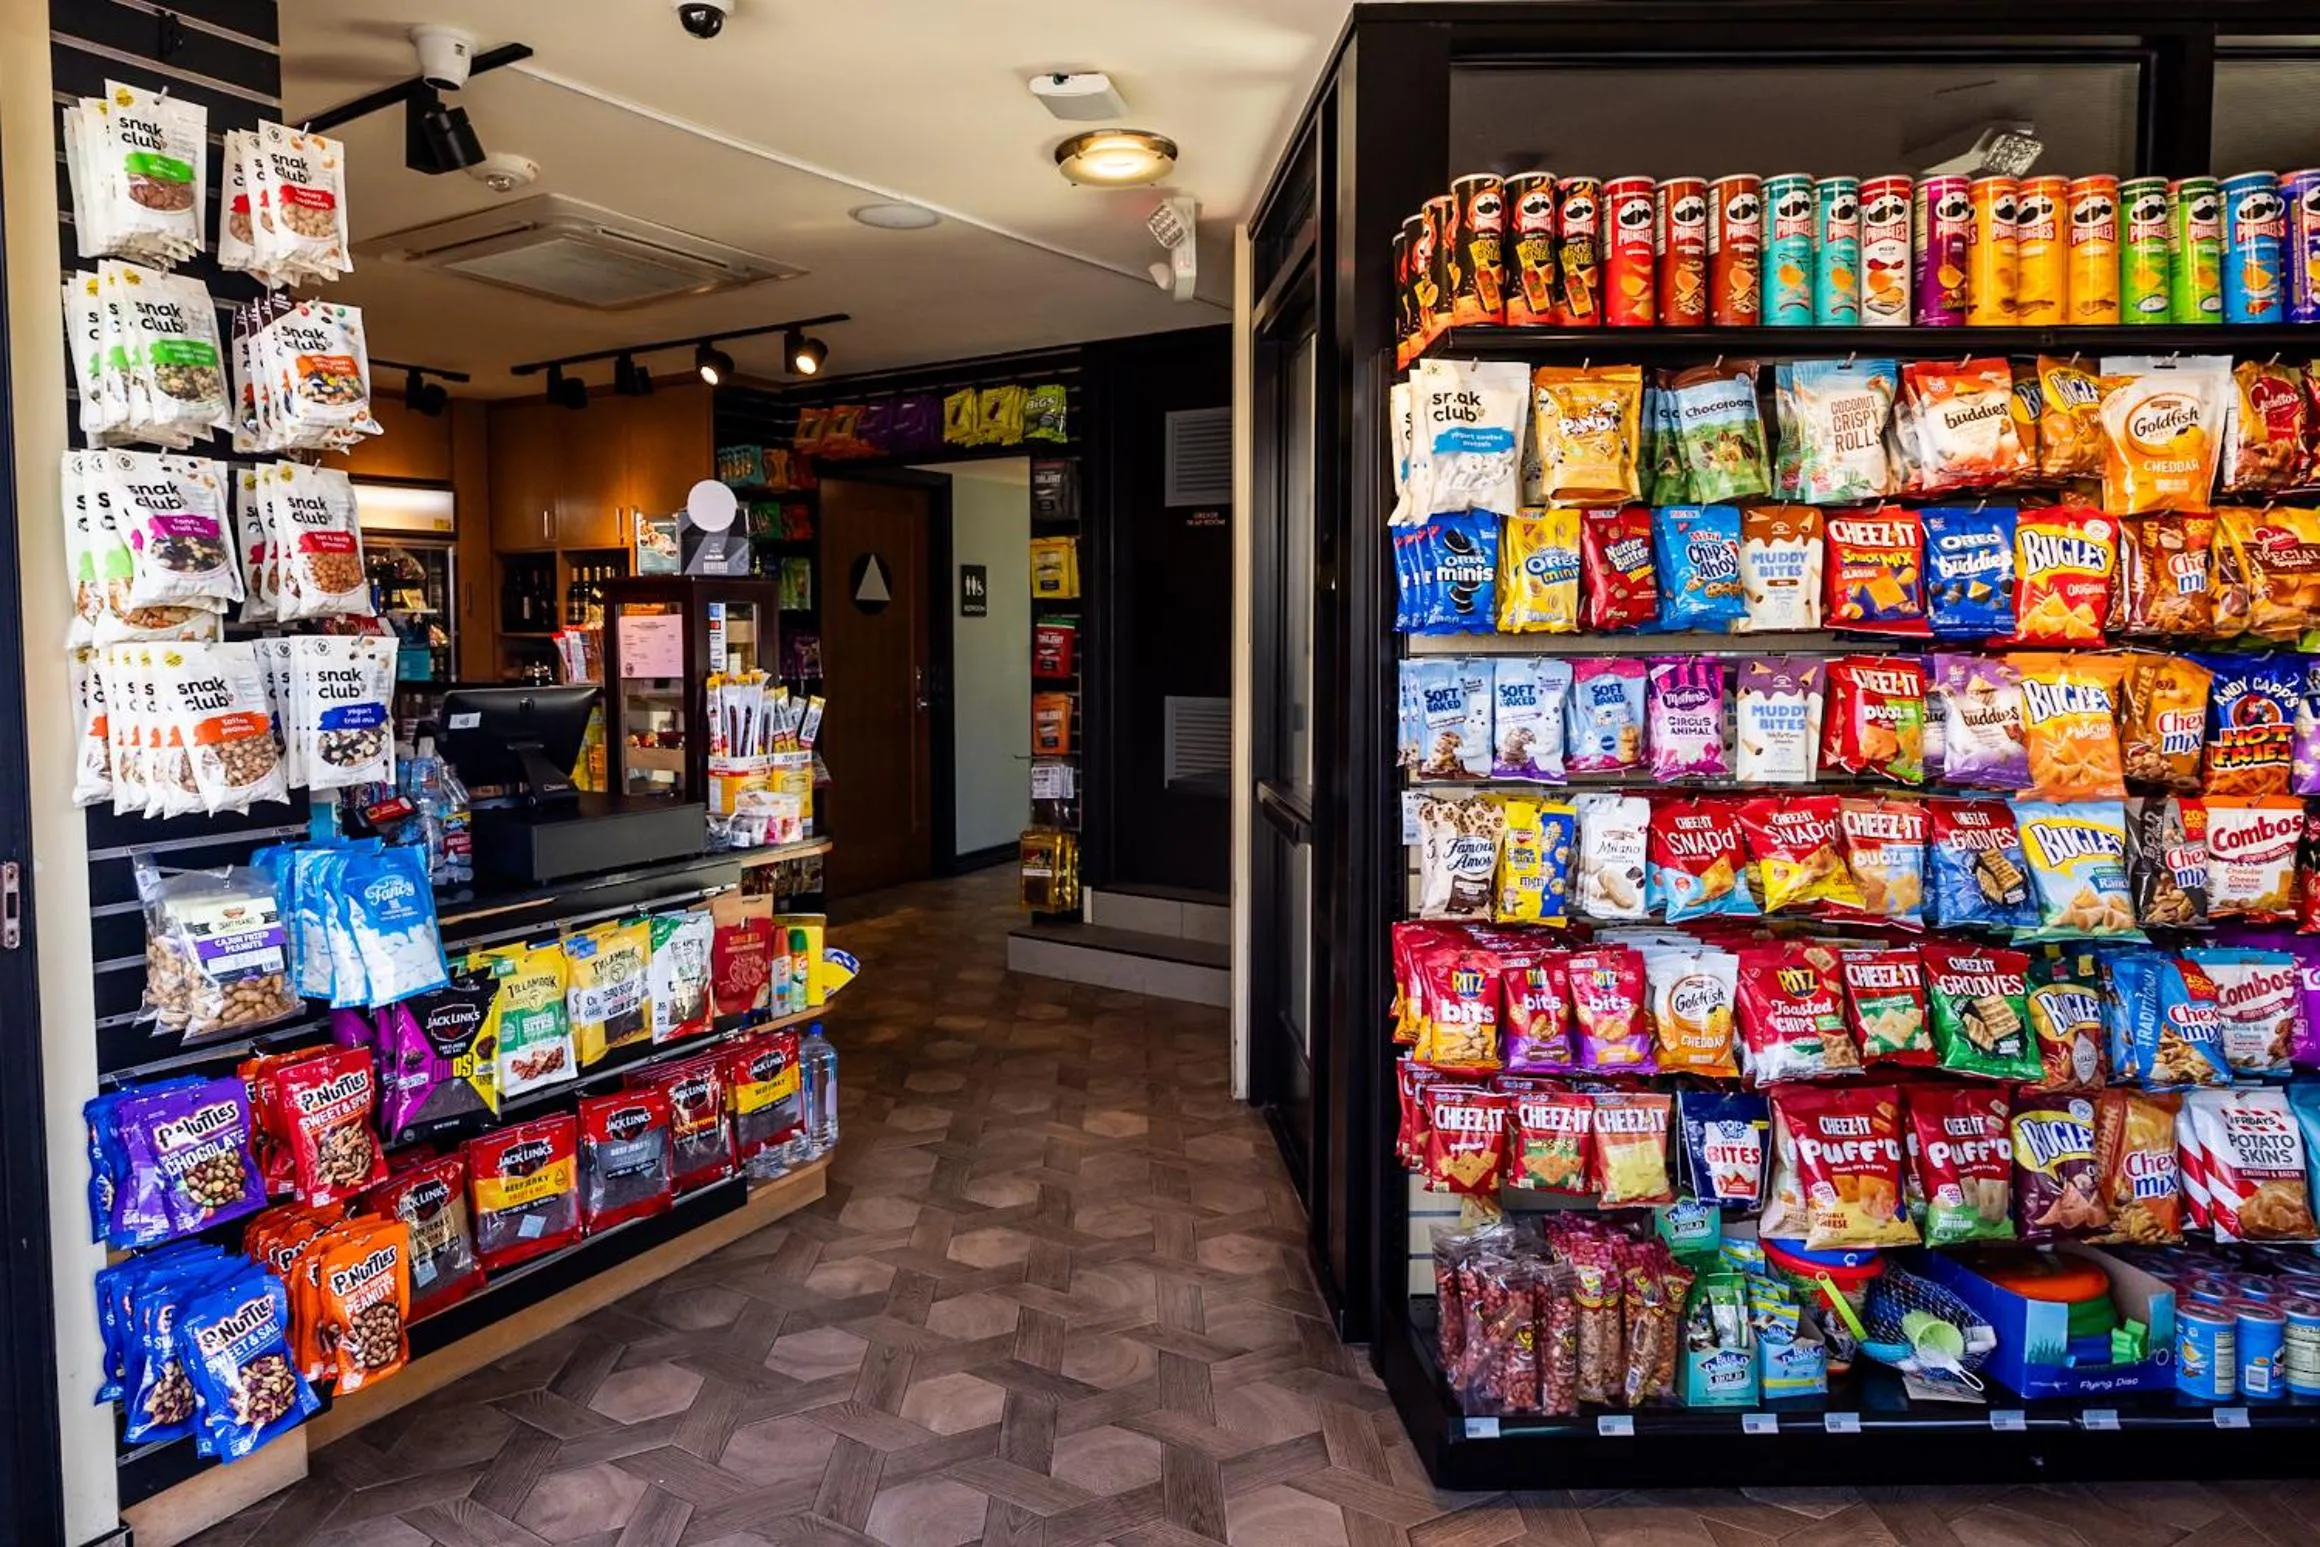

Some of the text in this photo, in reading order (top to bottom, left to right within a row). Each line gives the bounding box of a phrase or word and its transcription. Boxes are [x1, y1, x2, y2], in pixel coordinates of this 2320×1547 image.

[120, 114, 163, 138] snak
[121, 131, 162, 150] club
[270, 151, 308, 172] snak
[274, 165, 308, 184] club
[1864, 224, 1907, 247] PRINGLES
[136, 301, 181, 319] snak
[141, 316, 184, 334] club
[281, 324, 326, 341] snak
[1432, 390, 1482, 406] snak
[1830, 395, 1878, 415] COCONUT
[1433, 406, 1478, 422] club
[1833, 409, 1880, 433] CRISPY
[1944, 403, 2008, 429] buddies
[2134, 405, 2200, 437] Goldfish
[1834, 427, 1882, 453] ROLLS
[2144, 460, 2200, 473] CHEDDAR
[126, 481, 181, 496] snak
[135, 495, 182, 510] club
[287, 496, 328, 510] snak
[292, 510, 328, 525] club
[1828, 520, 1917, 548] CHEEZ-IT
[1940, 532, 2002, 550] OREO
[1604, 538, 1644, 558] Nutter
[1688, 541, 1730, 564] Chips
[1751, 551, 1808, 564] MUDDY
[2022, 530, 2108, 576] BUGLES
[1611, 549, 1650, 571] Butter
[1936, 549, 2014, 578] buddies
[1436, 565, 1495, 584] minis
[1758, 564, 1802, 578] BITES
[318, 668, 362, 683] snak
[178, 676, 229, 695] snak
[318, 682, 361, 698] club
[1498, 684, 1535, 698] SOFT
[1592, 683, 1623, 696] SOFT
[2214, 677, 2248, 707] ANDY
[184, 695, 230, 712] club
[1424, 688, 1459, 703] SOFT
[1594, 694, 1626, 706] BAKED
[1426, 700, 1462, 714] BAKED
[1752, 704, 1809, 717] MUDDY
[1668, 716, 1712, 728] CIRCUS
[1670, 726, 1712, 736] ANIMAL
[1760, 718, 1806, 730] BITES
[2220, 726, 2295, 748] HOT
[1675, 814, 1713, 829] CHEEZ-IT
[1771, 810, 1814, 826] CHEEZ-IT
[1843, 810, 1923, 840] CHEEZ-IT
[1667, 825, 1736, 858] SNAP'd
[1950, 828, 2020, 850] GROOVES
[2212, 814, 2304, 853] Combos
[2030, 823, 2124, 868] BUGLES
[1448, 856, 1494, 872] Amos
[214, 934, 242, 948] CAJUN
[1948, 956, 1996, 972] CHEEZ-IT
[1451, 970, 1486, 992] RITZ
[1776, 968, 1820, 993] RITZ
[1844, 964, 1922, 988] CHEEZ-IT
[1939, 974, 2026, 996] GROOVES
[2217, 968, 2296, 1008] Combos
[1522, 994, 1562, 1010] bits
[1588, 994, 1632, 1012] bits
[1675, 987, 1726, 1013] Goldfish
[1770, 998, 1834, 1016] Toasted
[428, 1010, 480, 1029] JACK LINK'S
[1442, 1000, 1496, 1024] bits
[1775, 1016, 1818, 1033] CHIPS
[1680, 1034, 1726, 1048] CHEDDAR
[606, 1118, 626, 1132] JACK
[1434, 1105, 1506, 1132] CHEEZ-IT
[1518, 1104, 1593, 1133] CHEEZ-IT
[1593, 1106, 1668, 1133] CHEEZ-IT
[1819, 1116, 1872, 1136] CHEEZ-IT
[2228, 1132, 2296, 1149] POTATO
[498, 1144, 553, 1170] JACK LINK'S
[1705, 1144, 1761, 1165] BITES
[1800, 1138, 1901, 1165] PUFF'D
[2240, 1149, 2294, 1164] SKINS
[2134, 1172, 2180, 1200] mix
[2079, 1376, 2138, 1392] Flying Disc
